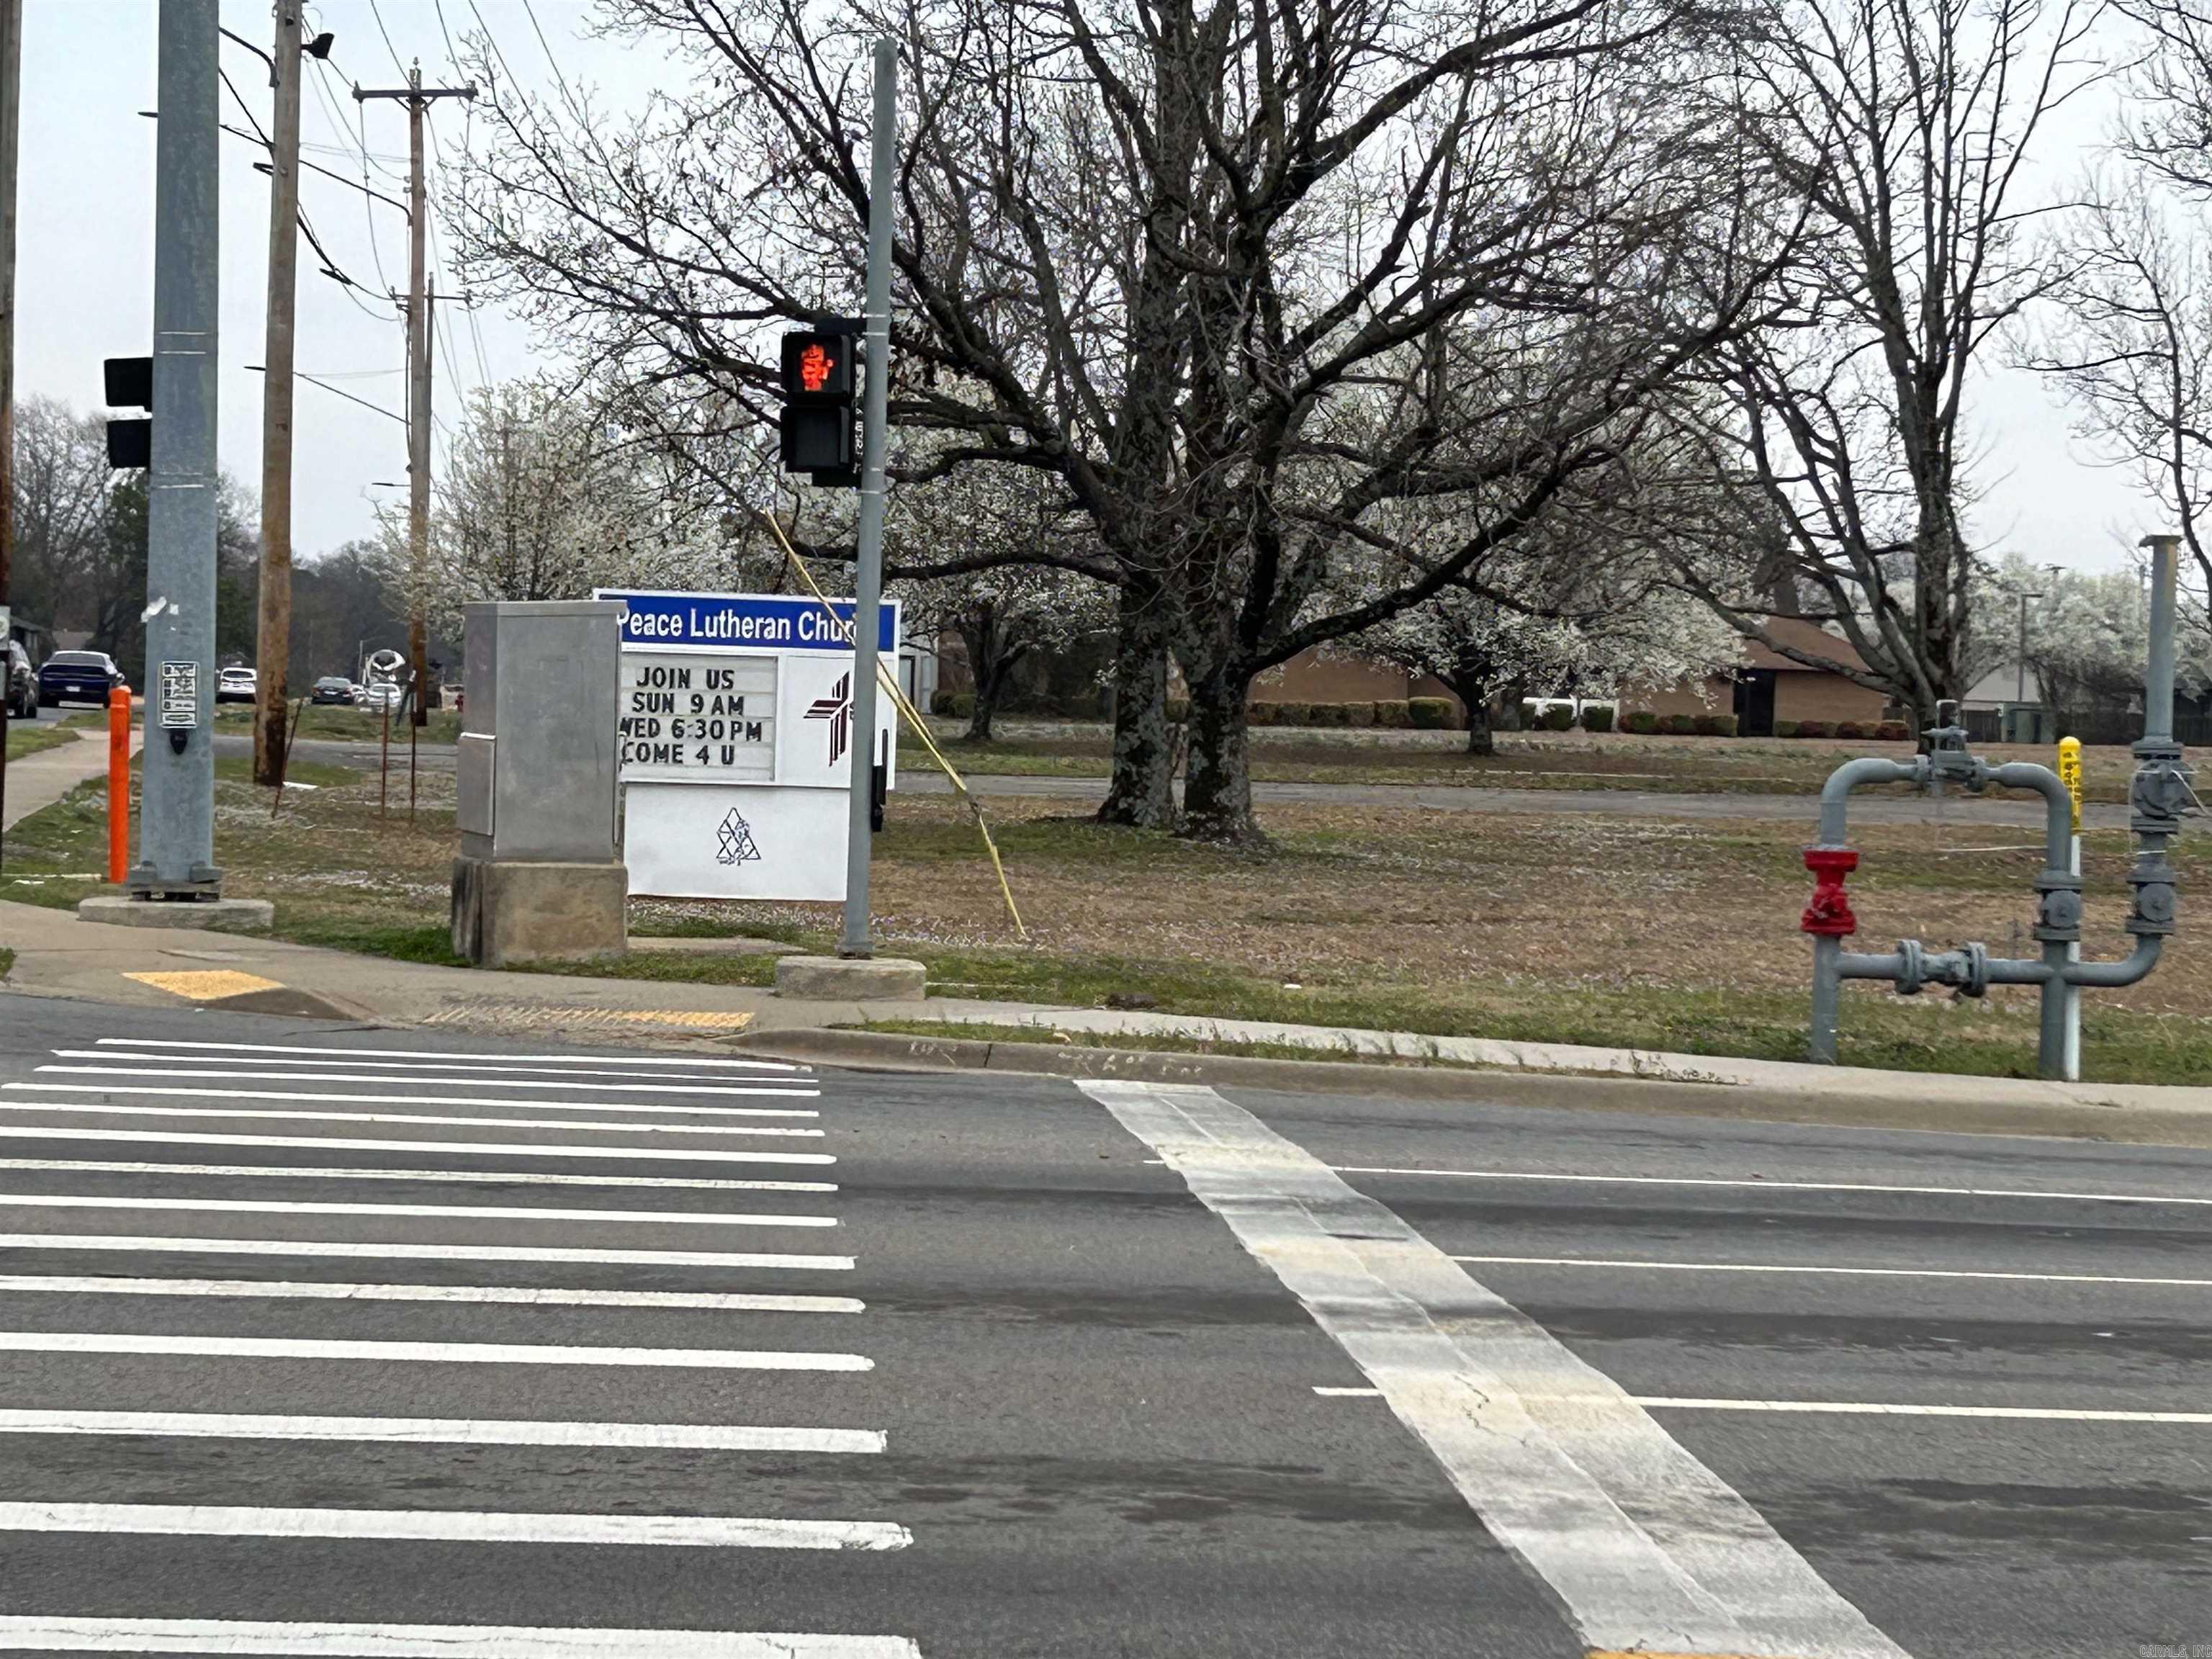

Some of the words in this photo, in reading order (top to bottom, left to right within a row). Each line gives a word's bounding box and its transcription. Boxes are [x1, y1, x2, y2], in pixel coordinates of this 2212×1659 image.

[616, 608, 683, 637] Peace
[691, 608, 791, 641] Lutheran
[799, 611, 856, 642] Chur
[637, 667, 691, 689] JOIN
[706, 669, 734, 690] US
[632, 692, 675, 714] SUN
[620, 717, 660, 738] WED
[696, 745, 709, 765] 4
[721, 745, 734, 765] U
